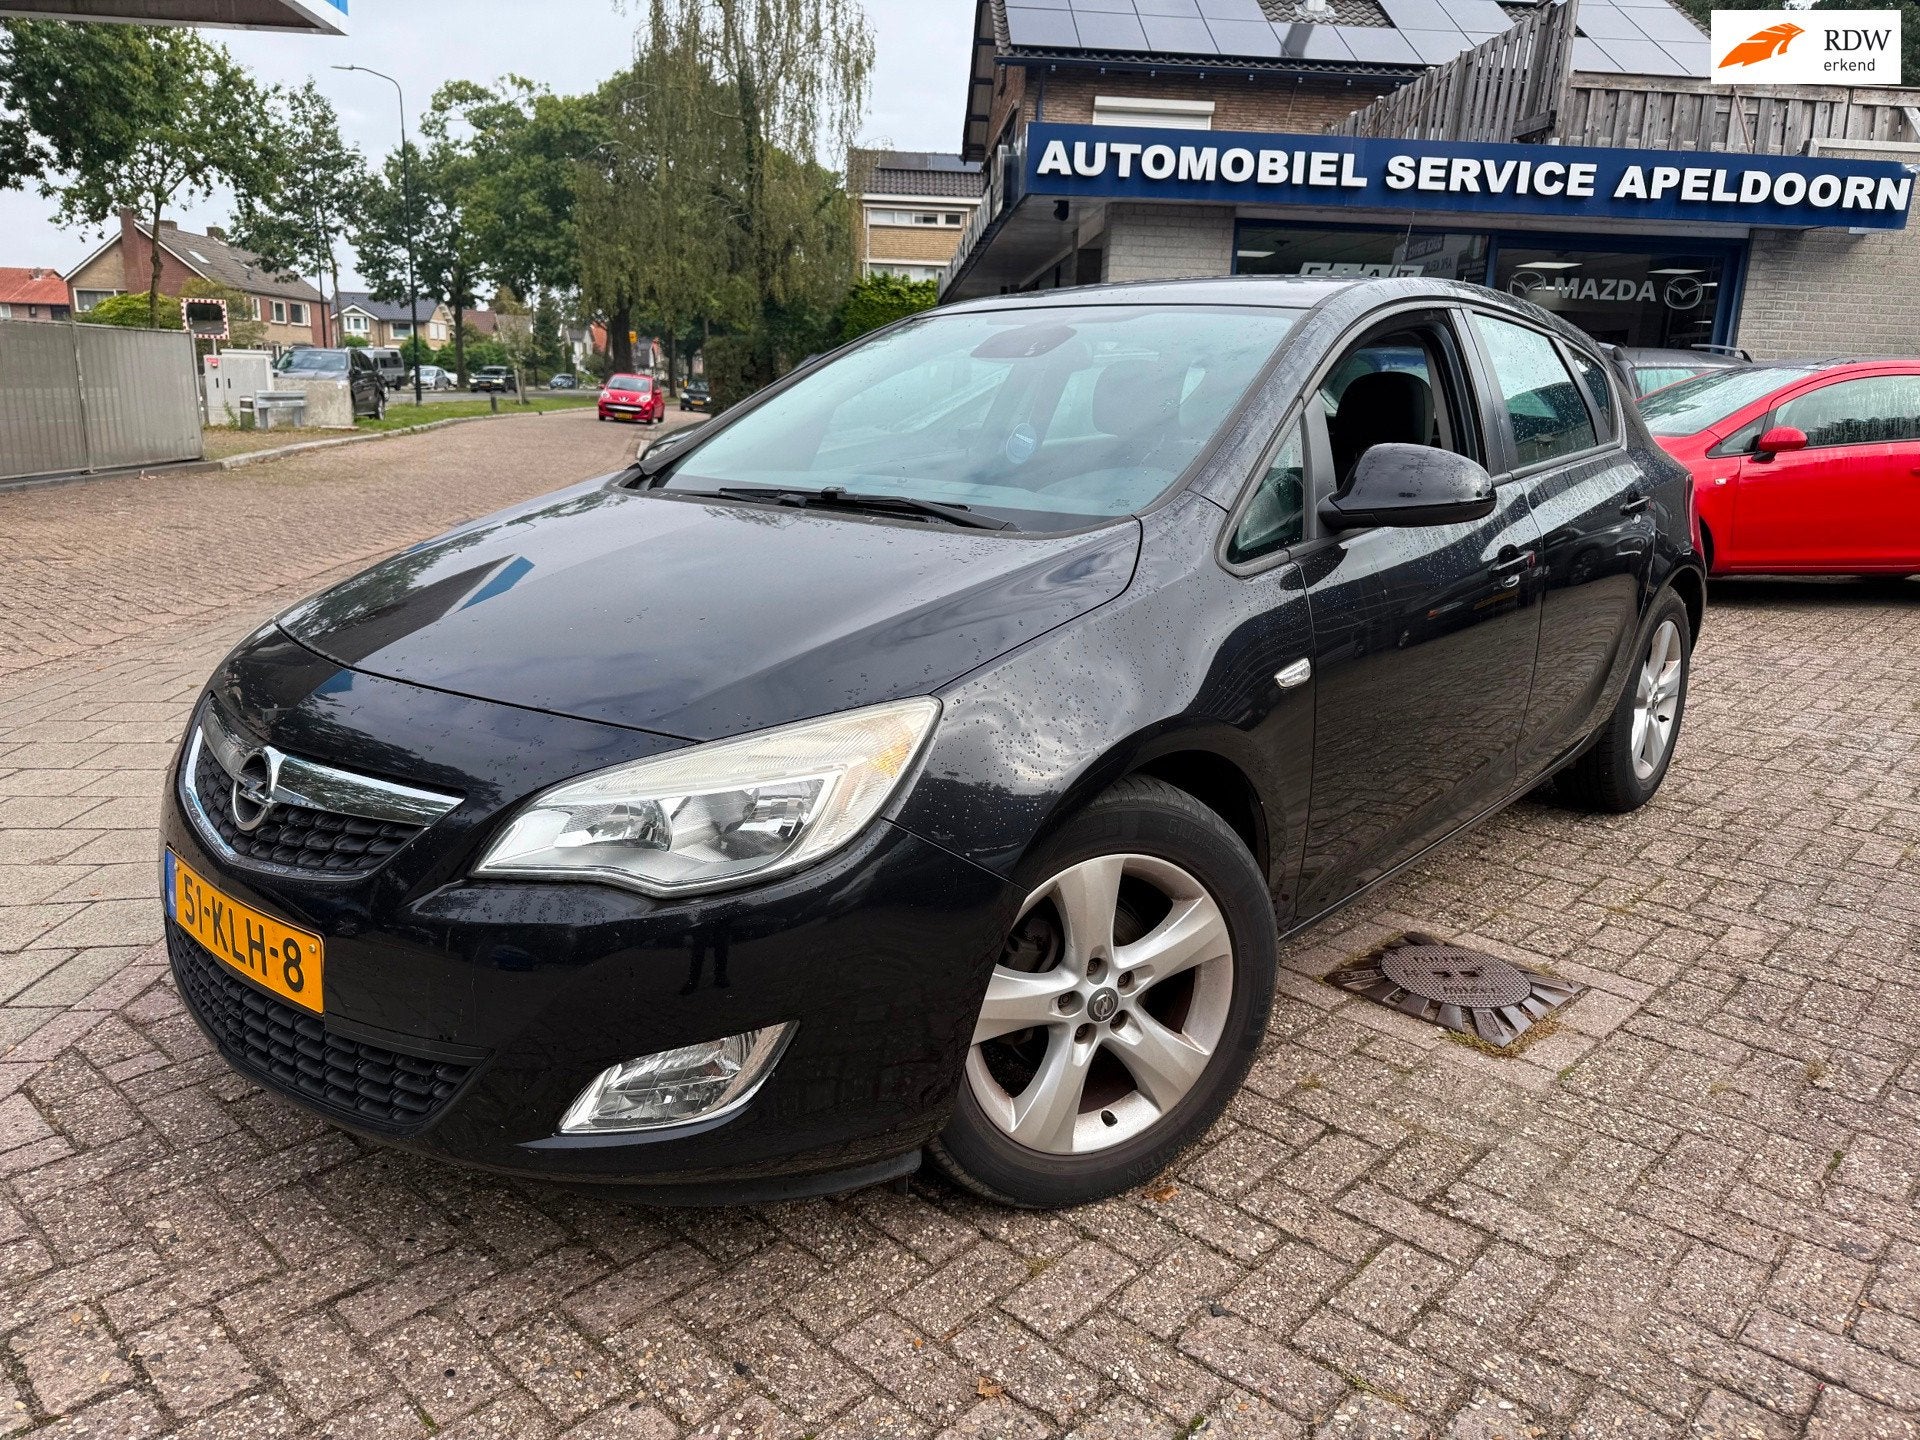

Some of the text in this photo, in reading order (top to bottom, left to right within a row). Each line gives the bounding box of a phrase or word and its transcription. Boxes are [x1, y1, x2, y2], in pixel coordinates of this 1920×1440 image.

[1036, 139, 1912, 211] AUTOMOBIEL SERVICE APELDOORN
[1554, 277, 1657, 303] MAZDA
[184, 873, 304, 993] 51-KLH-8
